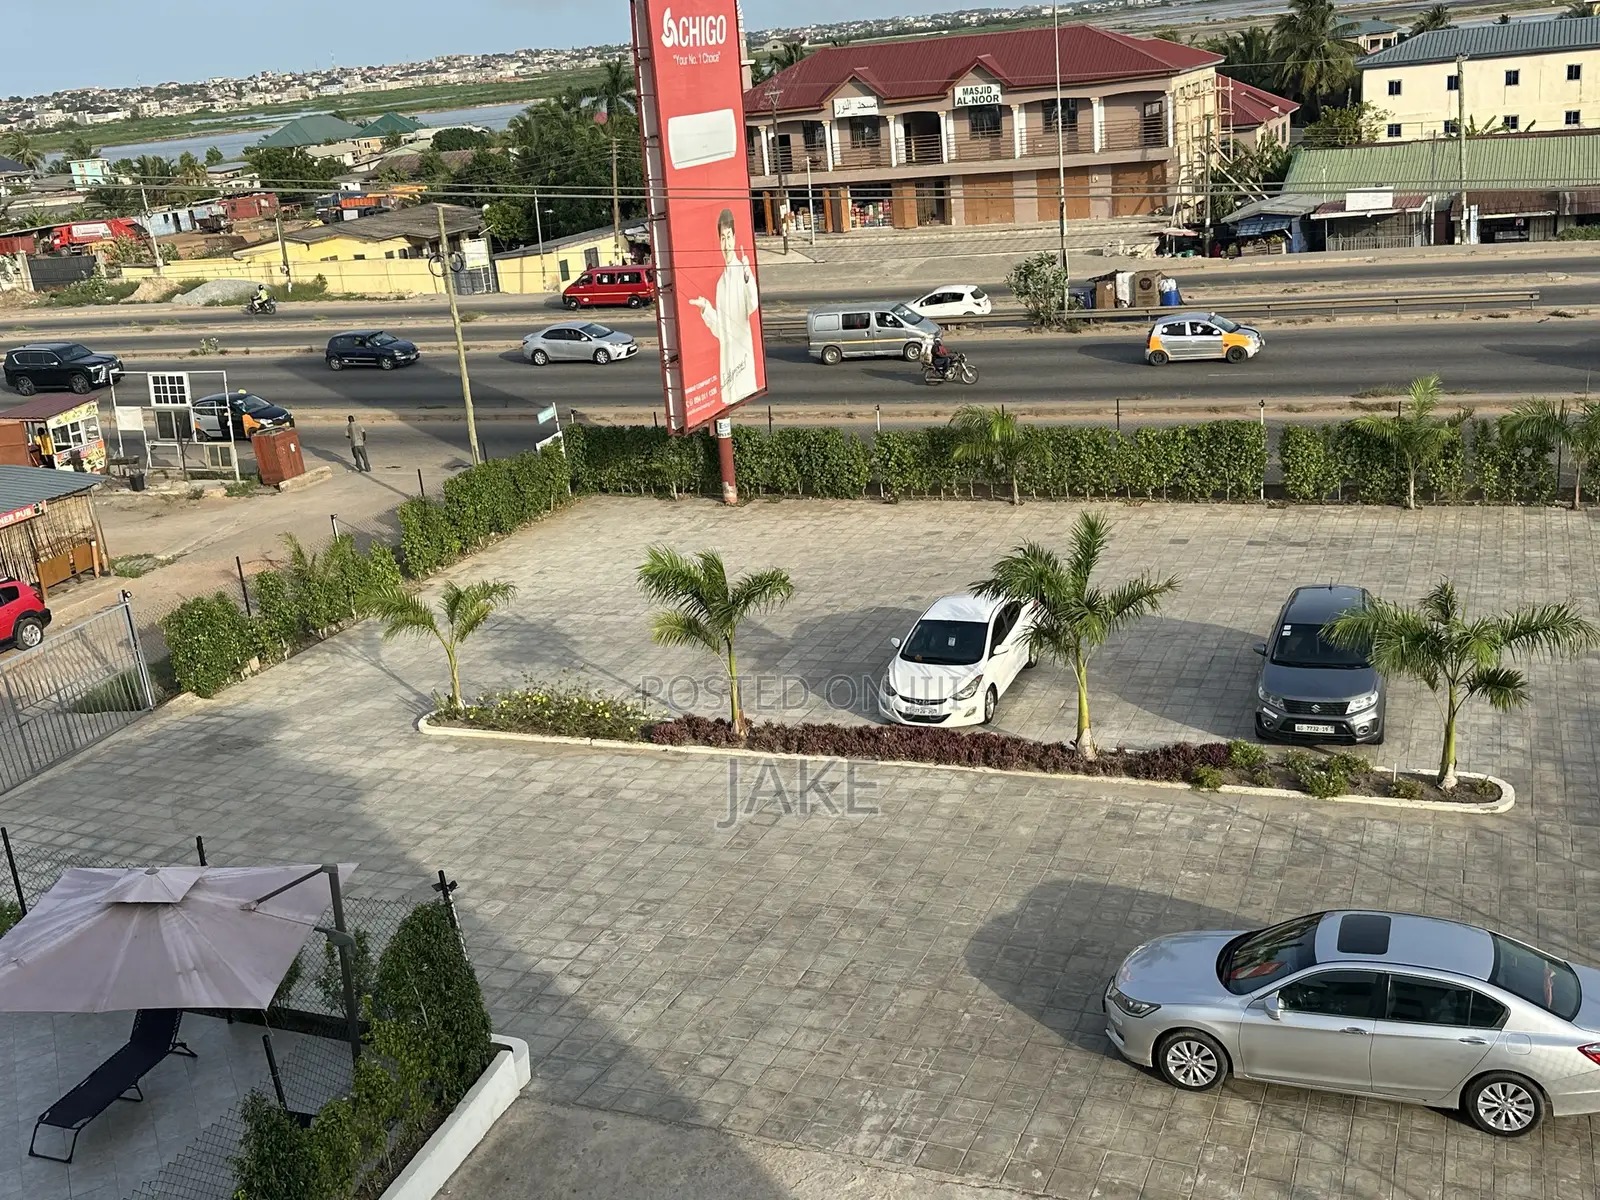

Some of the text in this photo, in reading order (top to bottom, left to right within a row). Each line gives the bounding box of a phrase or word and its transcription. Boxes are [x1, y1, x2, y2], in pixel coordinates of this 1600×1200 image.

[679, 15, 726, 47] CHIGO
[962, 86, 992, 96] MASJID
[956, 94, 1000, 105] AL-NOOR
[15, 508, 32, 519] PUB
